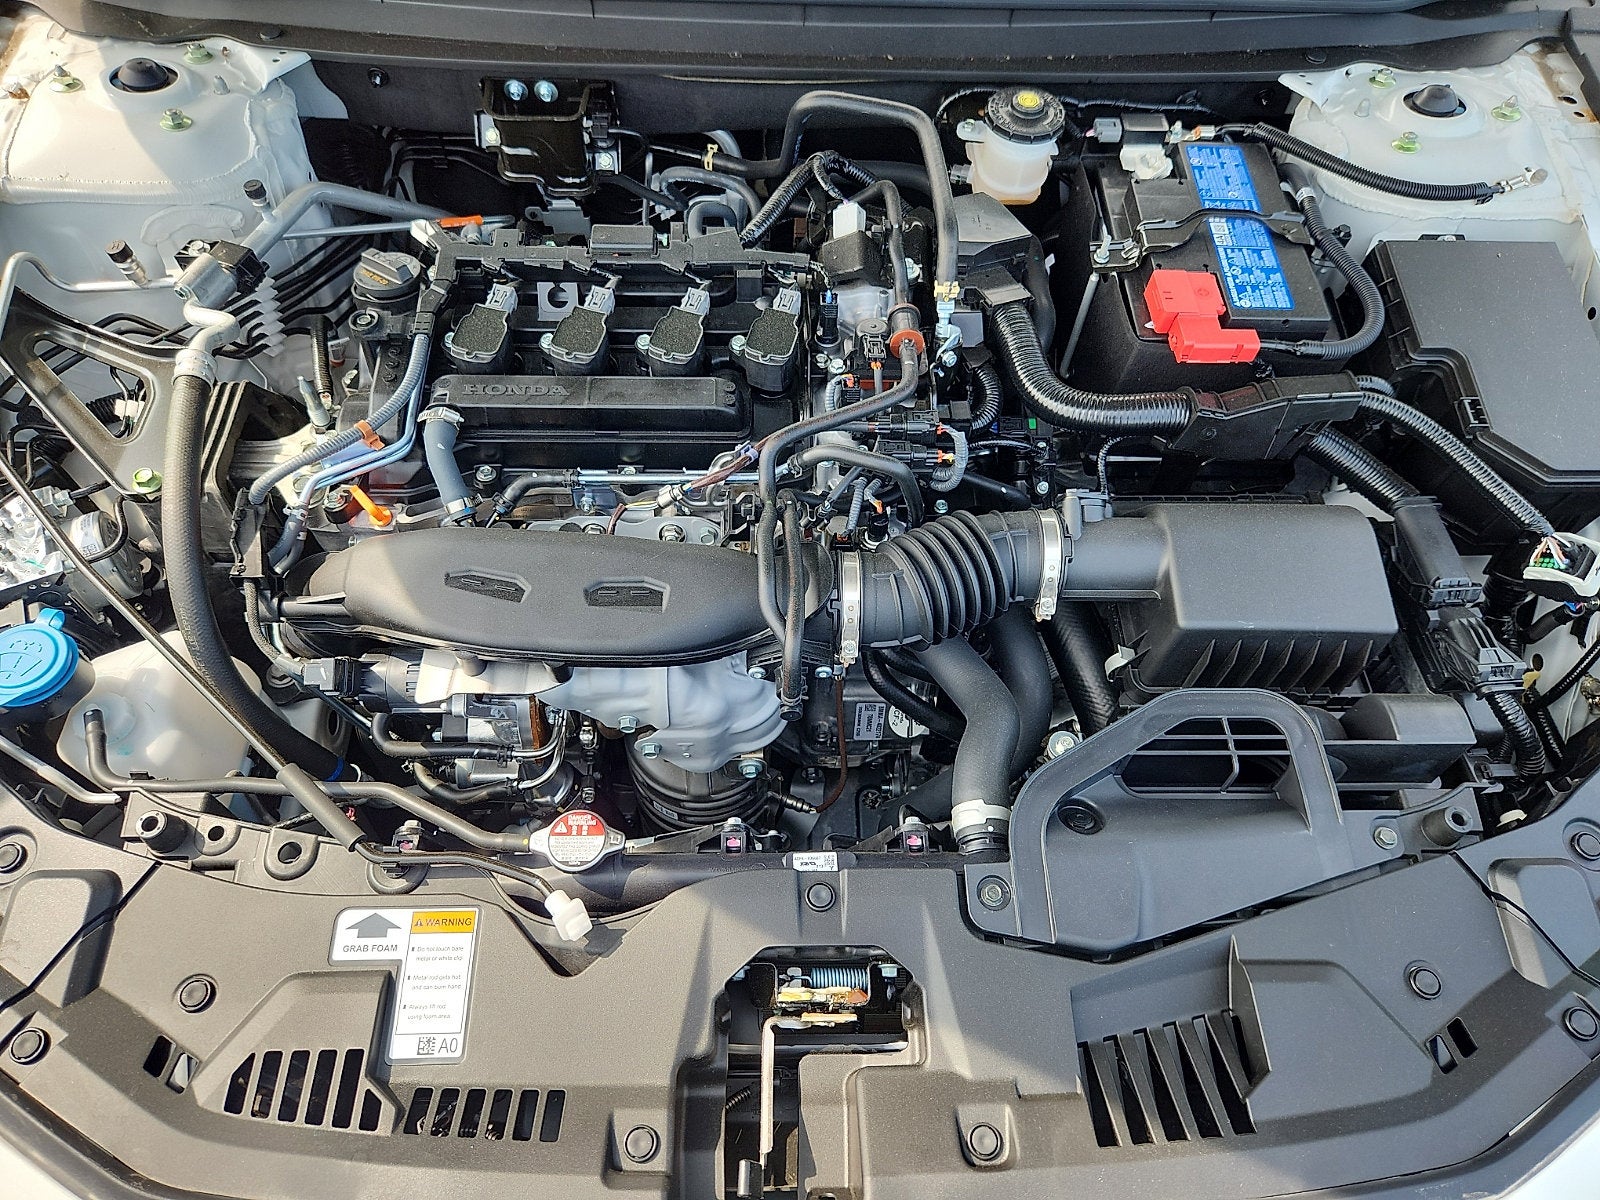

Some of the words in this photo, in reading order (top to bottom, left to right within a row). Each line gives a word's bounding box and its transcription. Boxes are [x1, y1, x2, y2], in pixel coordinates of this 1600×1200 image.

[462, 384, 570, 396] HONDA
[425, 917, 472, 926] WARNING
[342, 944, 369, 952] GRAB
[371, 944, 398, 952] FOAM
[438, 1037, 458, 1053] A0
